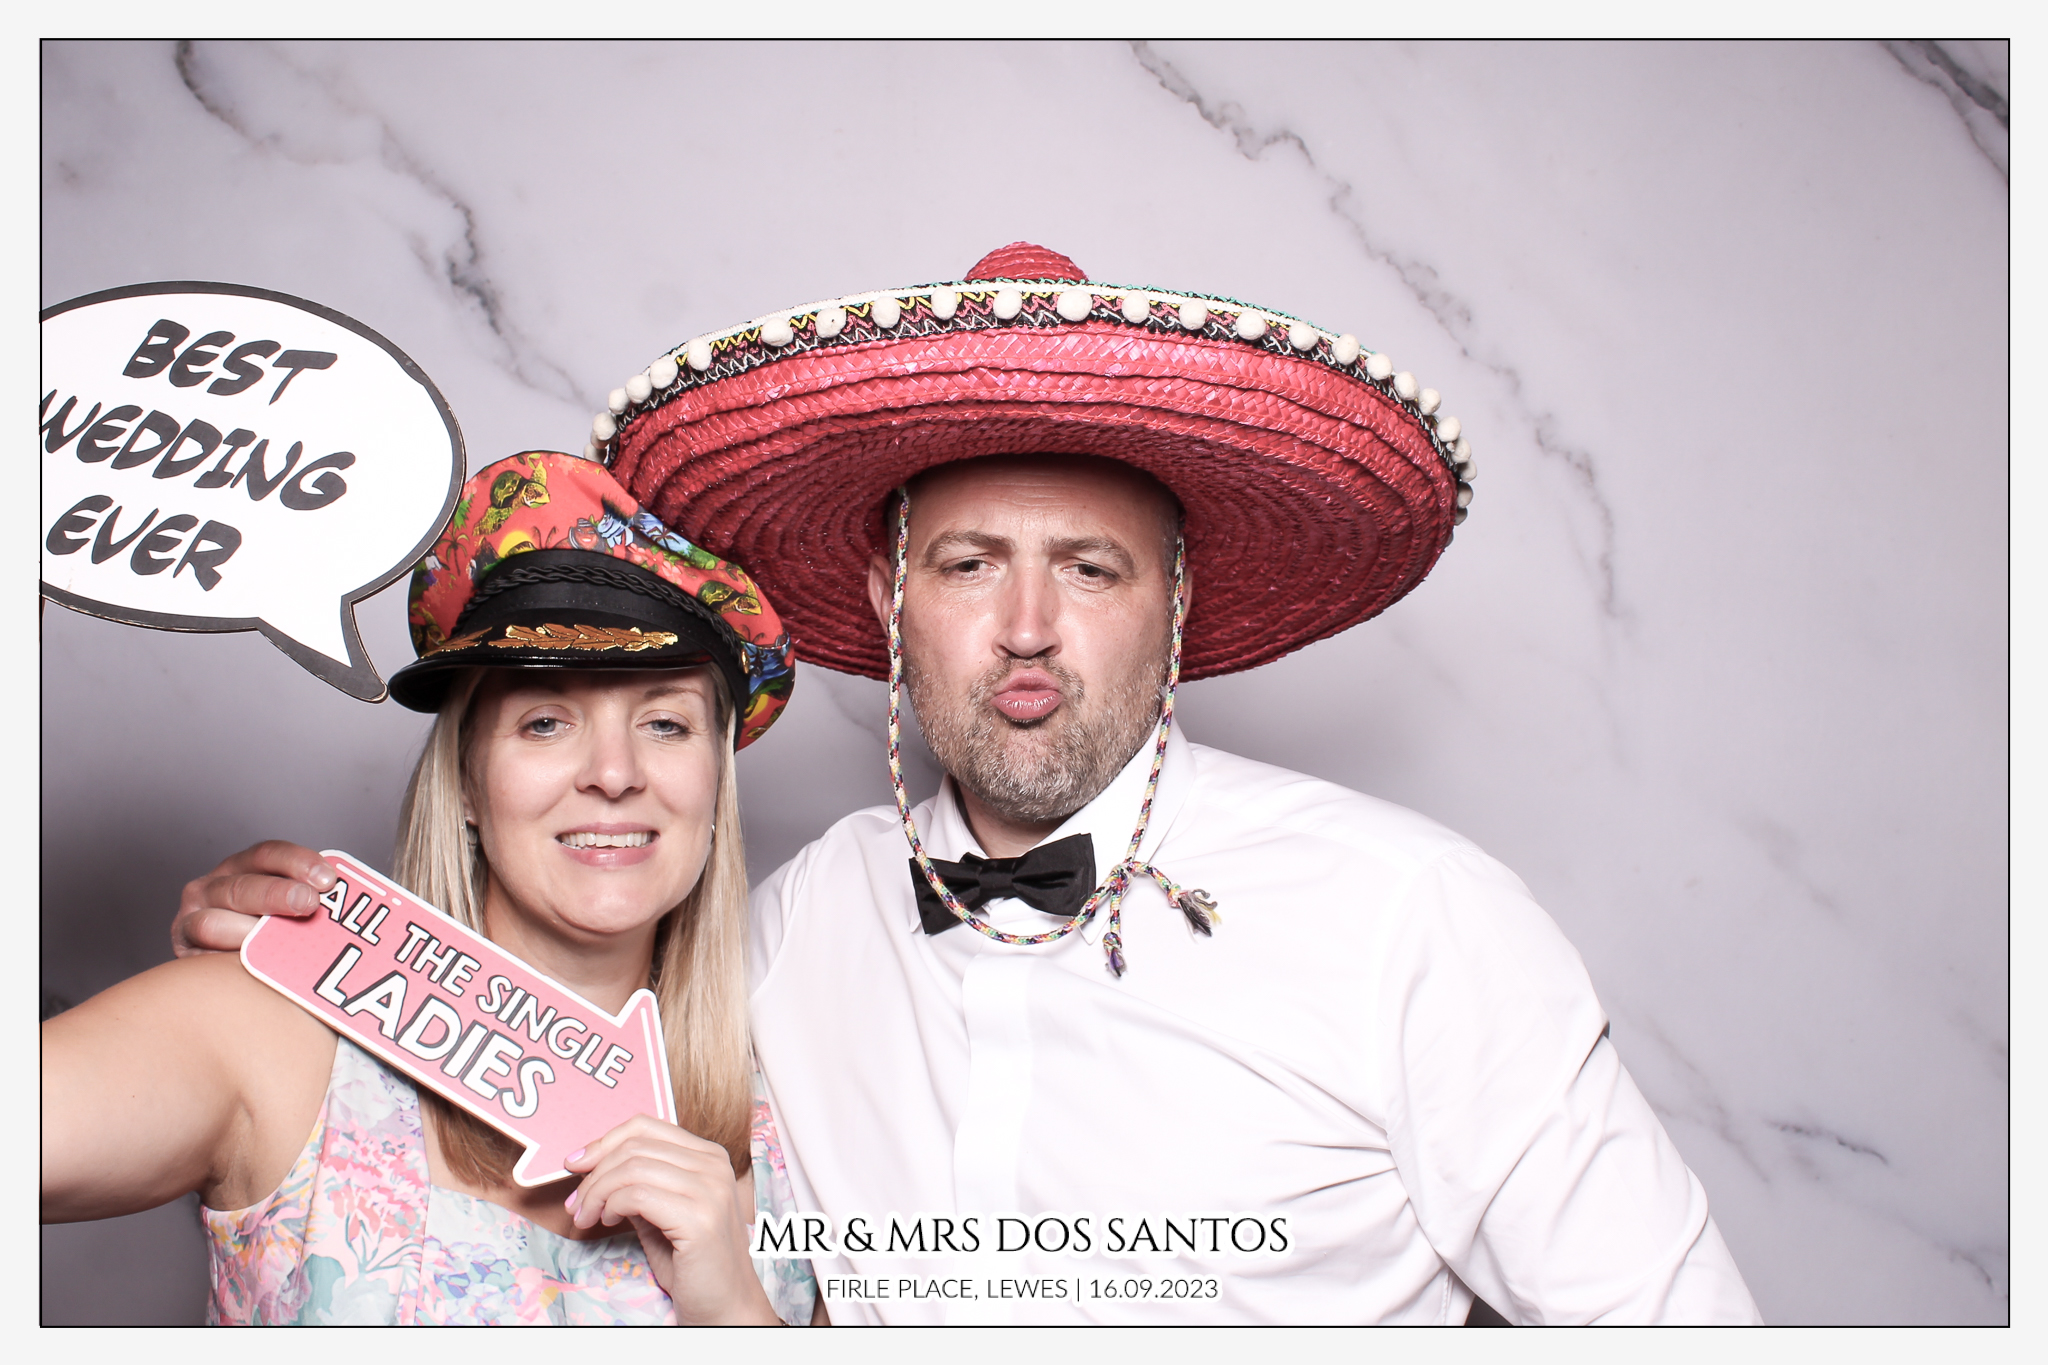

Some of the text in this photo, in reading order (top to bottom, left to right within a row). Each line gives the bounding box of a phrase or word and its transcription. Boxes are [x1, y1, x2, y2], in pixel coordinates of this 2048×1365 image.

[123, 319, 338, 405] BEST
[40, 389, 356, 511] WEDDING
[46, 495, 242, 592] EVER
[313, 943, 556, 1119] LADIES
[318, 877, 634, 1090] ALL THE SINGLE
